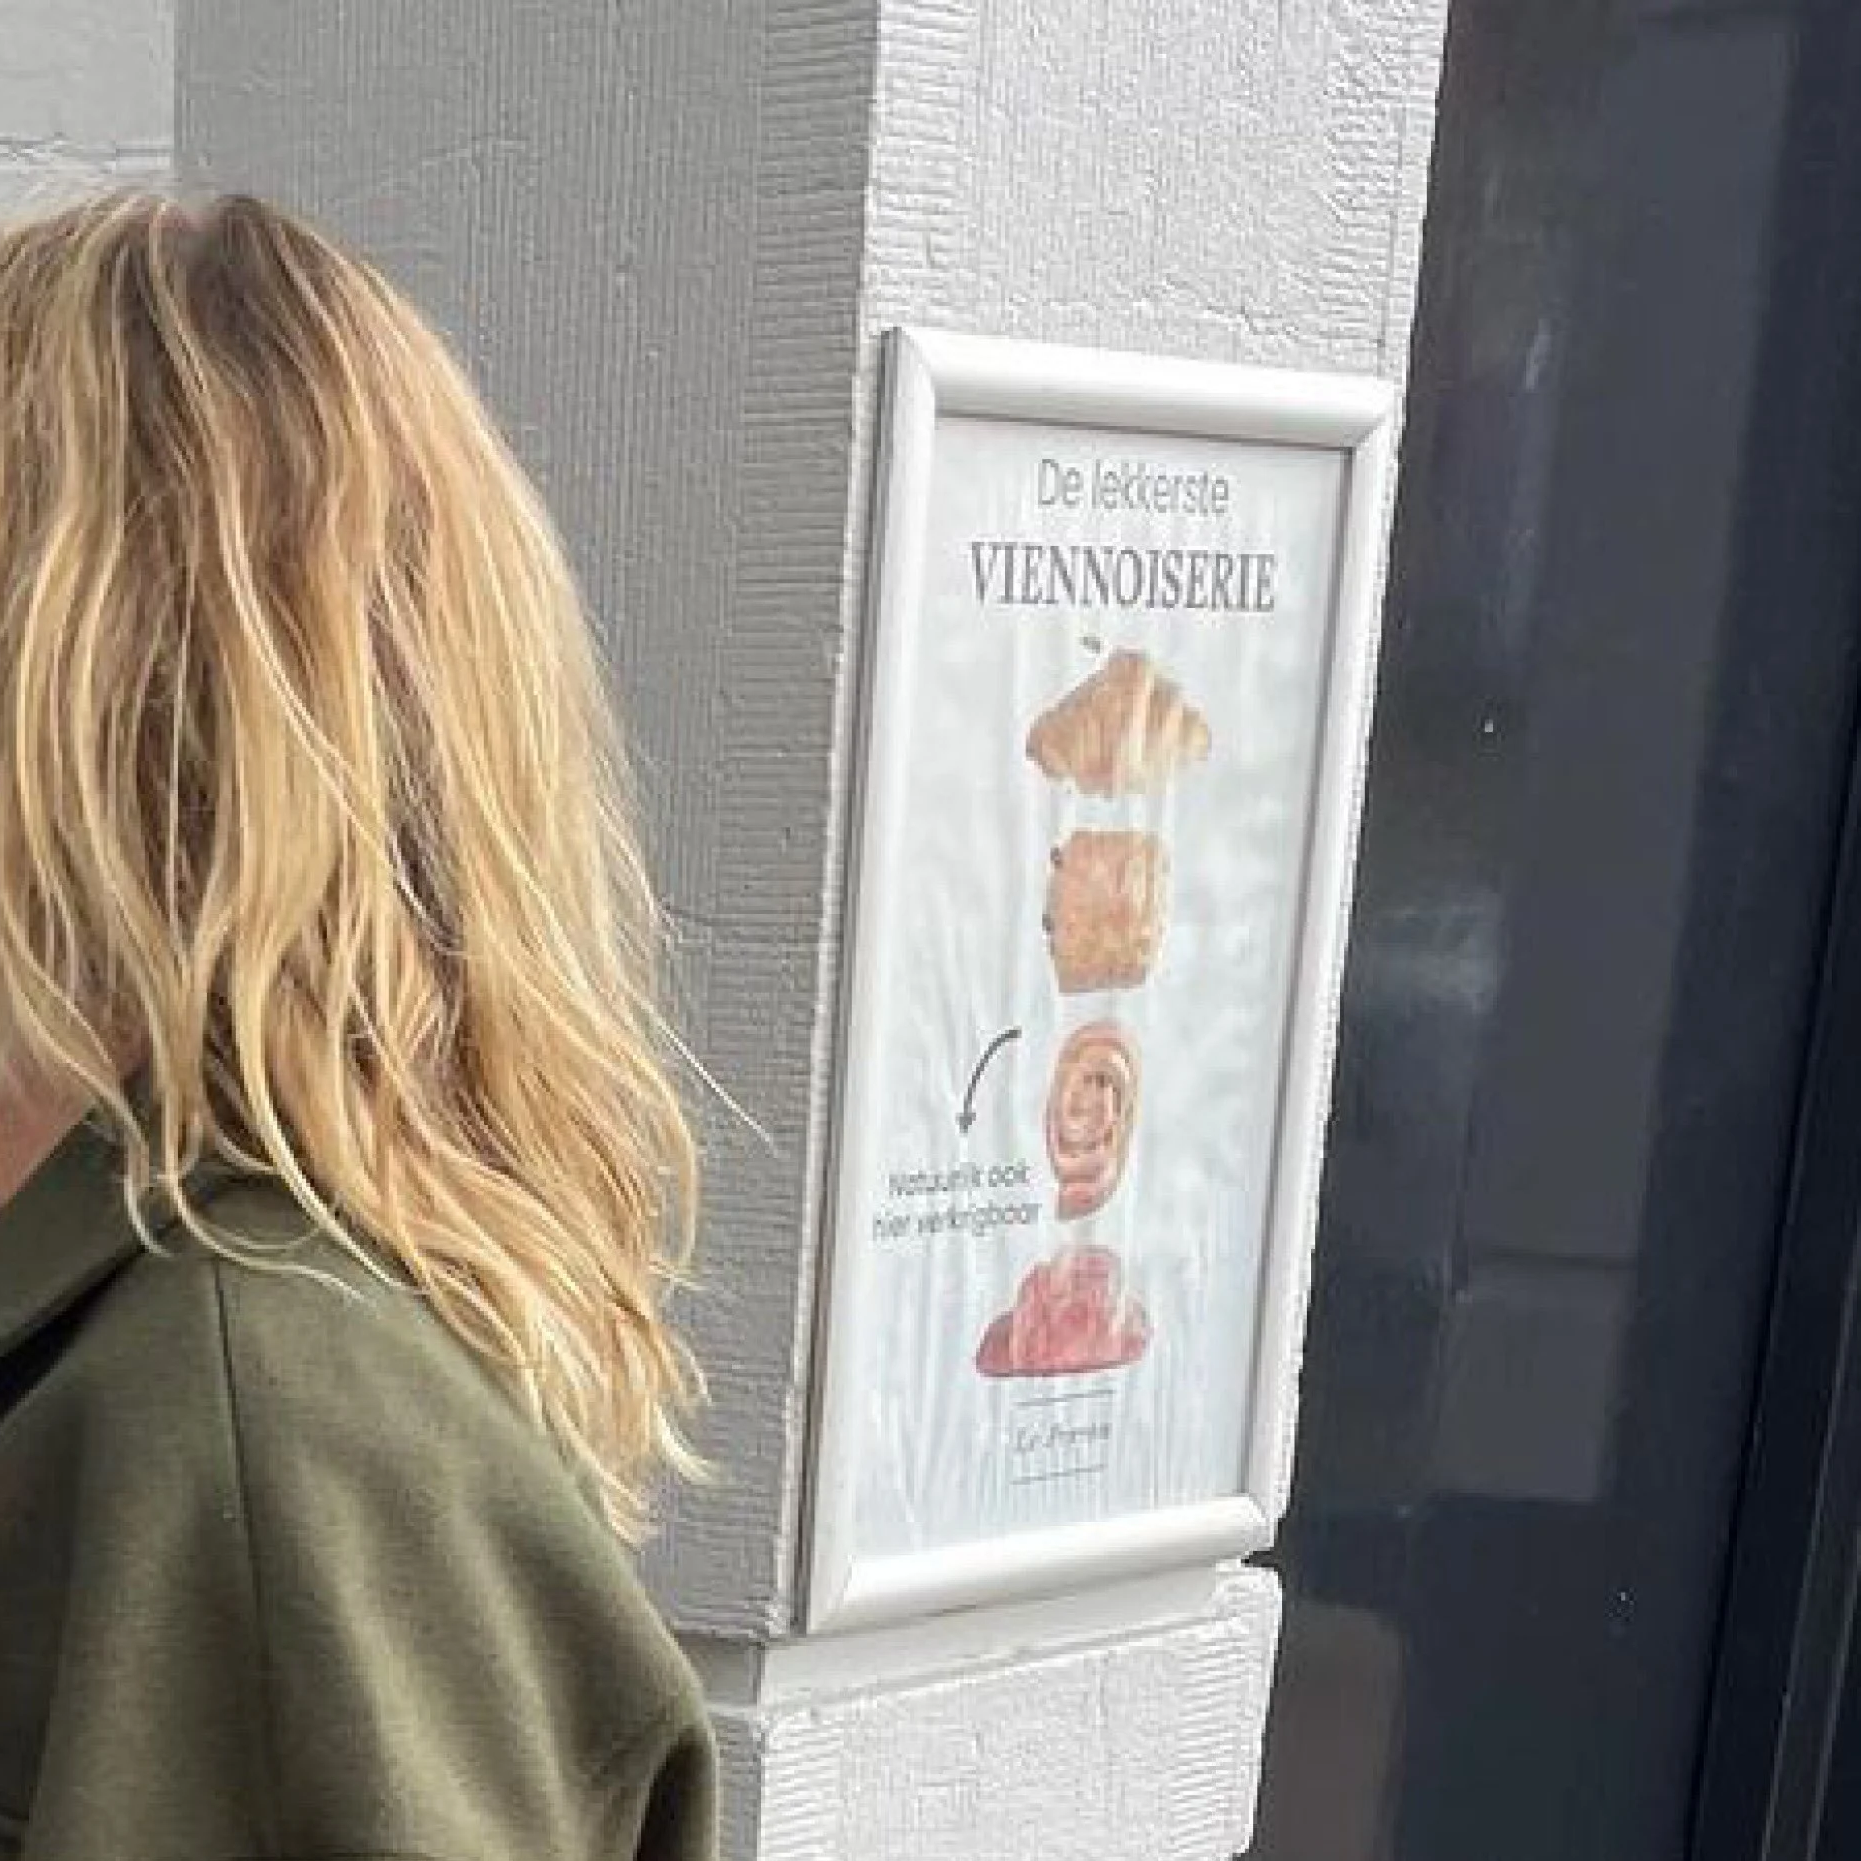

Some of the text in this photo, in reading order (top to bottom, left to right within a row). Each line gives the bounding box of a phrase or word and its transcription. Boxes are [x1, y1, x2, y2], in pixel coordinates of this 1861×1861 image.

[1038, 458, 1230, 516] De lekkerste
[971, 541, 1275, 612] VIENNOISERIE
[988, 1157, 1032, 1189] ook
